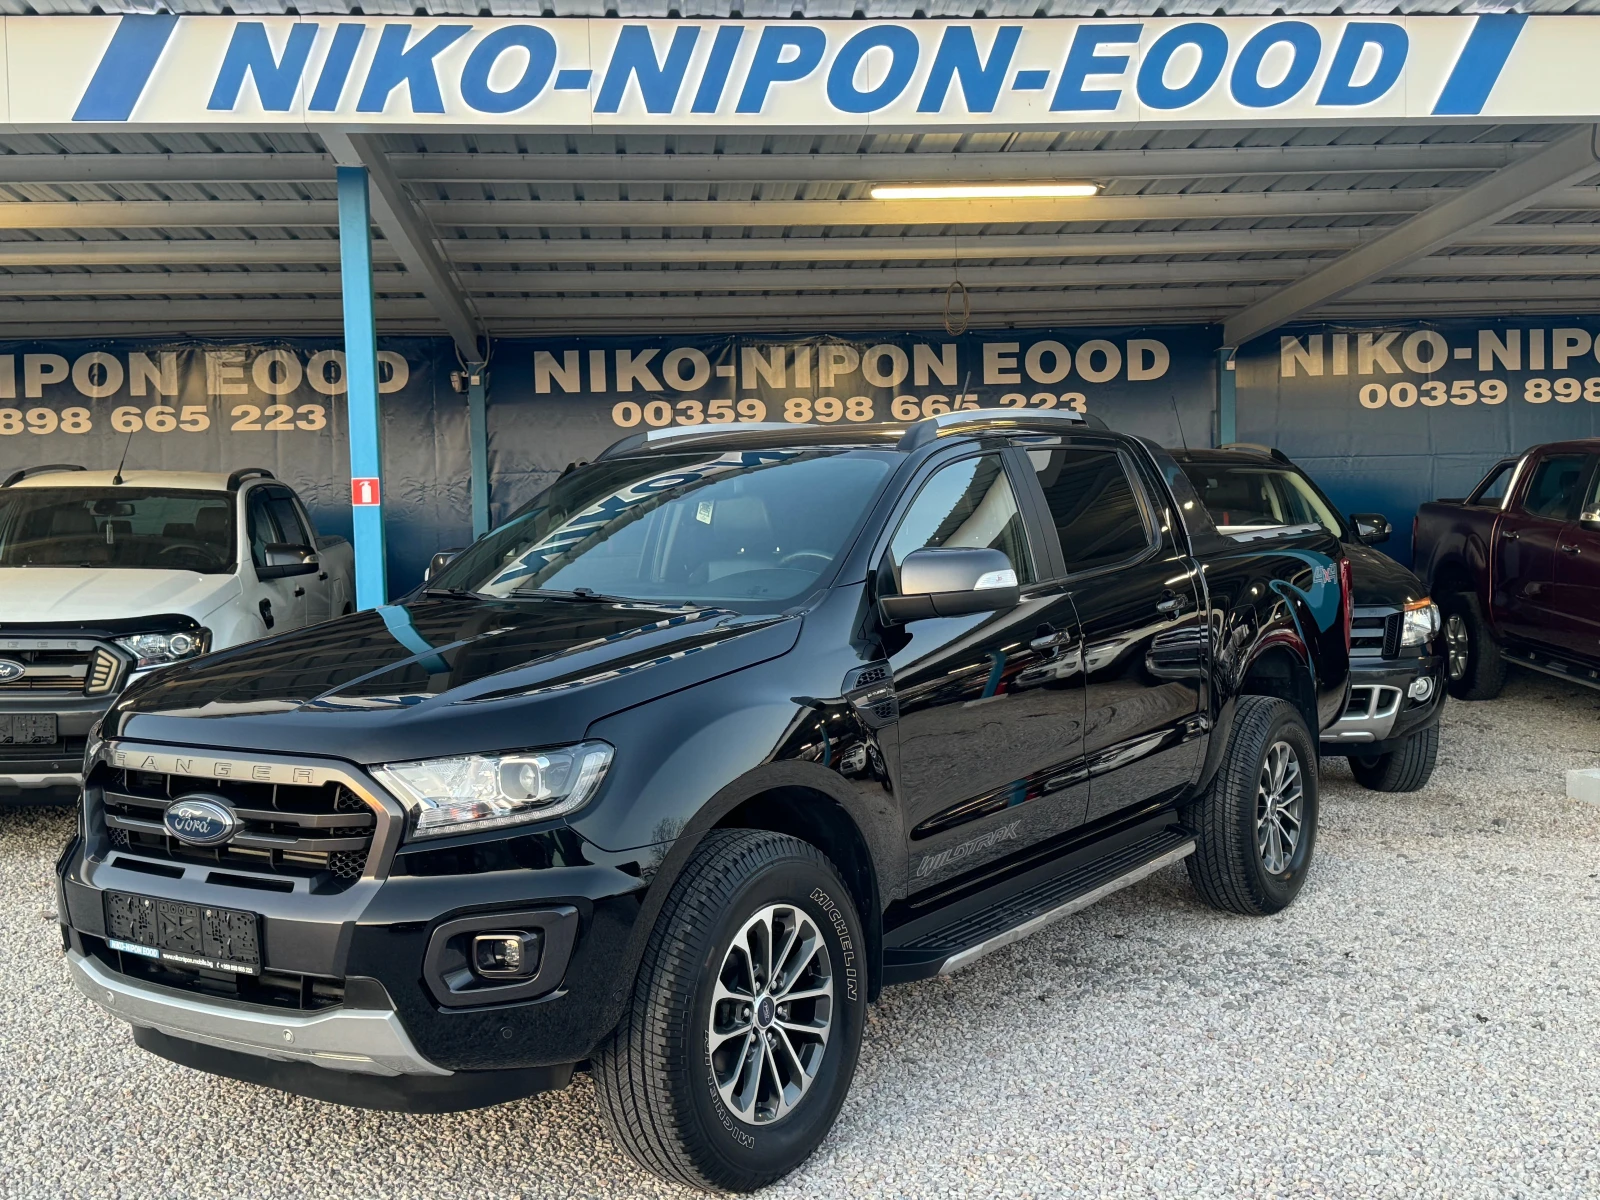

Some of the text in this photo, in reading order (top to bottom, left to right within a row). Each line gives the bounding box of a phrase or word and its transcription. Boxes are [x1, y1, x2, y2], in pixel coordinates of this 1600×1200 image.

[206, 22, 1409, 114] NIKO-NIPON-EOOD
[205, 348, 410, 396] EOOD
[533, 338, 1170, 394] NIKO-NIPON EOOD
[1280, 328, 1600, 378] NIKO-NIP
[110, 404, 211, 433] 665
[230, 403, 327, 431] 223
[612, 398, 767, 428] 00359
[783, 395, 874, 424] 898
[1358, 379, 1508, 409] 00359
[114, 751, 314, 784] RANGER
[175, 806, 212, 834] Ford
[916, 819, 1021, 878] WILDTRAK
[810, 887, 858, 1002] MICHELIN
